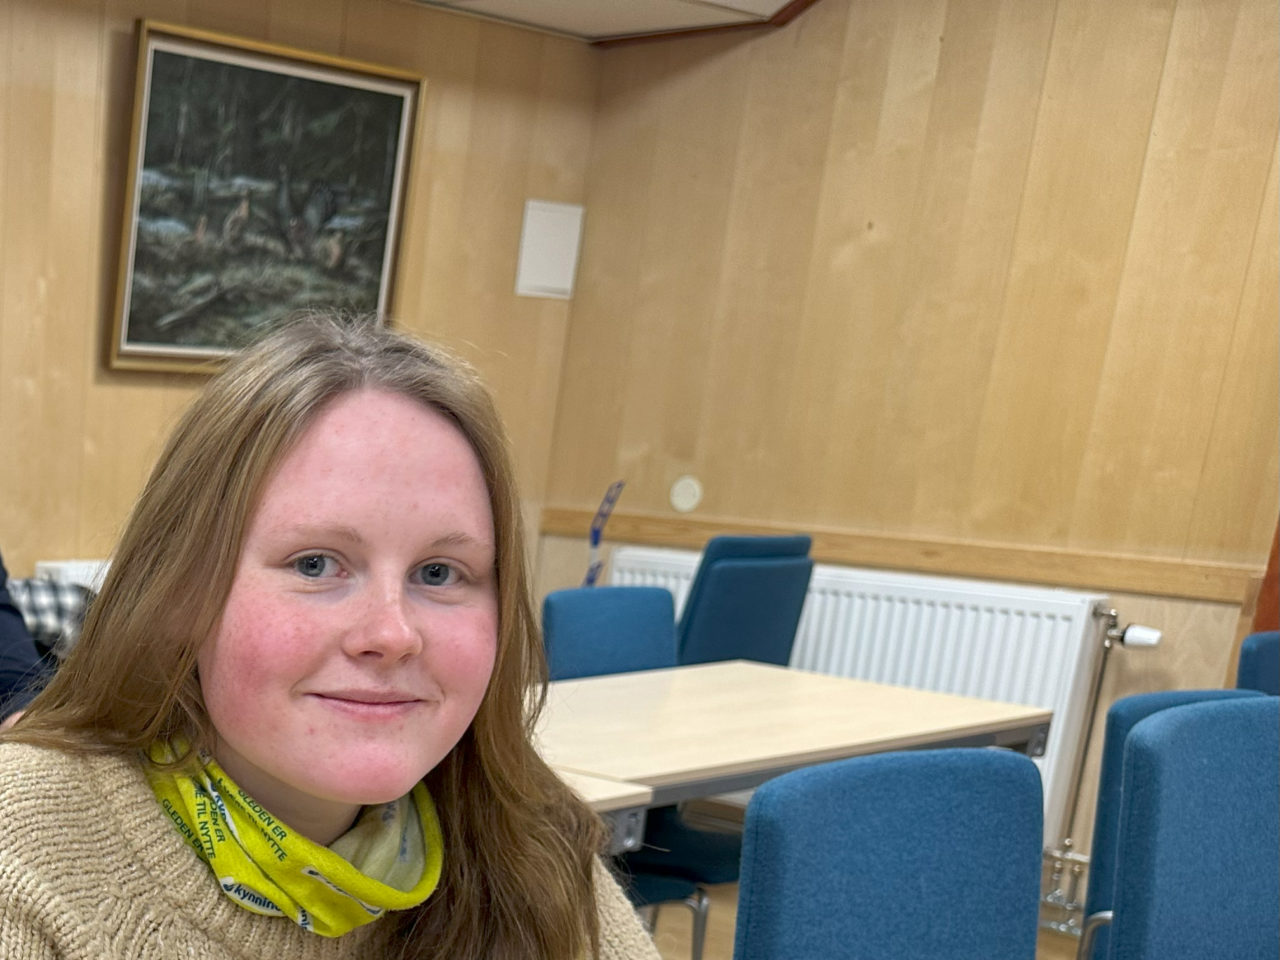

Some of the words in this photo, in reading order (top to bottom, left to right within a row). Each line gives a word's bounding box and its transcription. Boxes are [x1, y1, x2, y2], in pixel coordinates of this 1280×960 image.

[162, 798, 194, 839] GLEDEN
[196, 801, 207, 819] TIL
[198, 821, 216, 859] NYTTE
[214, 828, 226, 842] ER
[271, 825, 287, 841] ER
